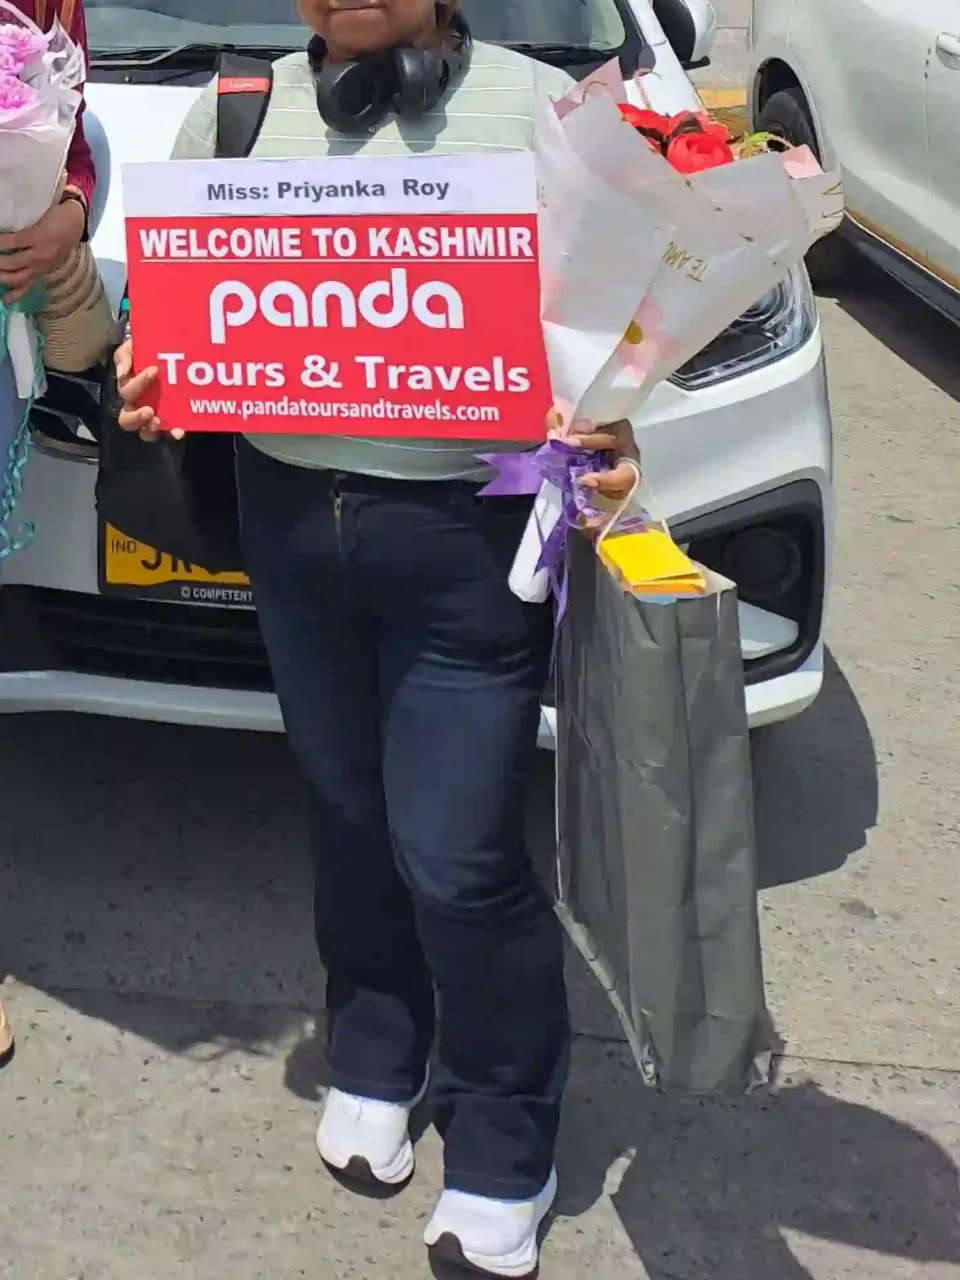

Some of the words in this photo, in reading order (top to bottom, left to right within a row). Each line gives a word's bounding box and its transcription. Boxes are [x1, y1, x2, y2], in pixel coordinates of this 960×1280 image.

[207, 183, 269, 201] Miss:
[277, 180, 386, 202] Priyanka
[403, 178, 450, 199] Roy
[140, 228, 303, 258] WELCOME
[312, 228, 357, 258] TO
[369, 226, 534, 257] KASHMIR
[209, 267, 465, 344] panda
[157, 352, 286, 387] Tours
[301, 354, 342, 388] &
[355, 355, 530, 393] Travels
[190, 395, 500, 421] www.pandatoursandtravels.com
[111, 539, 137, 554] IND
[193, 587, 254, 602] COMPETENT
